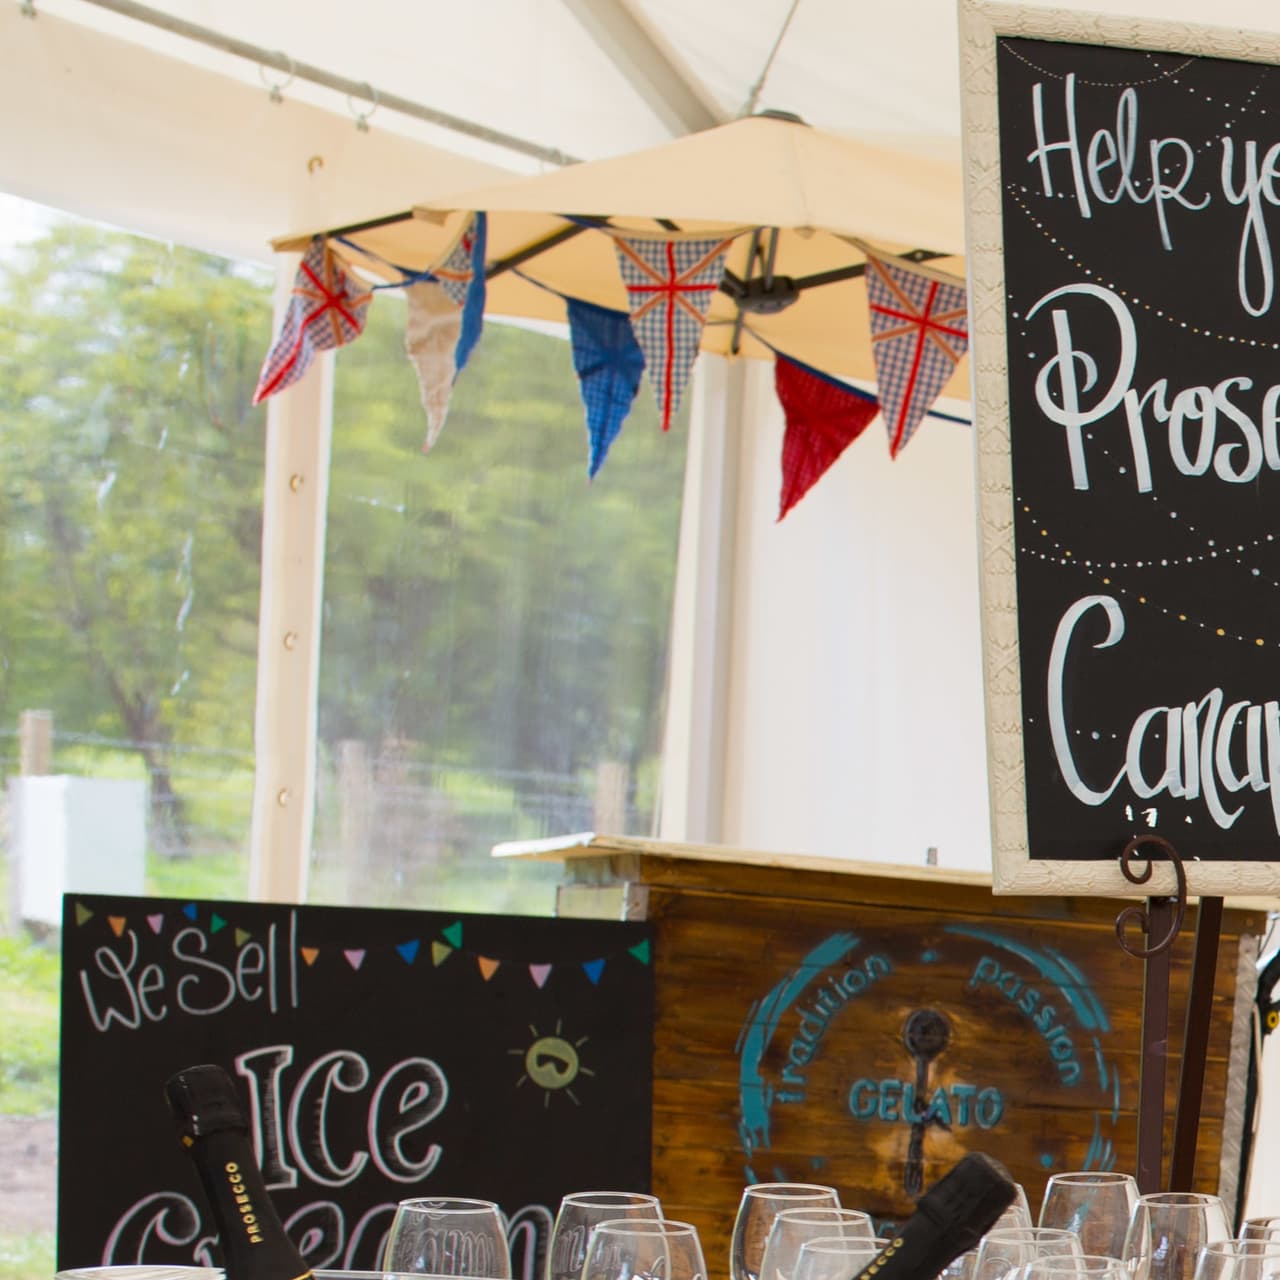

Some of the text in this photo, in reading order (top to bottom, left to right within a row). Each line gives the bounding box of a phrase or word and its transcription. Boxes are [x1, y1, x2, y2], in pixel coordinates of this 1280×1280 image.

[1026, 73, 1211, 250] Help
[80, 909, 298, 1032] We Sell
[776, 954, 1080, 1103] tradition passion
[849, 1078, 1003, 1129] GELATO
[225, 1162, 264, 1244] PROSECCO
